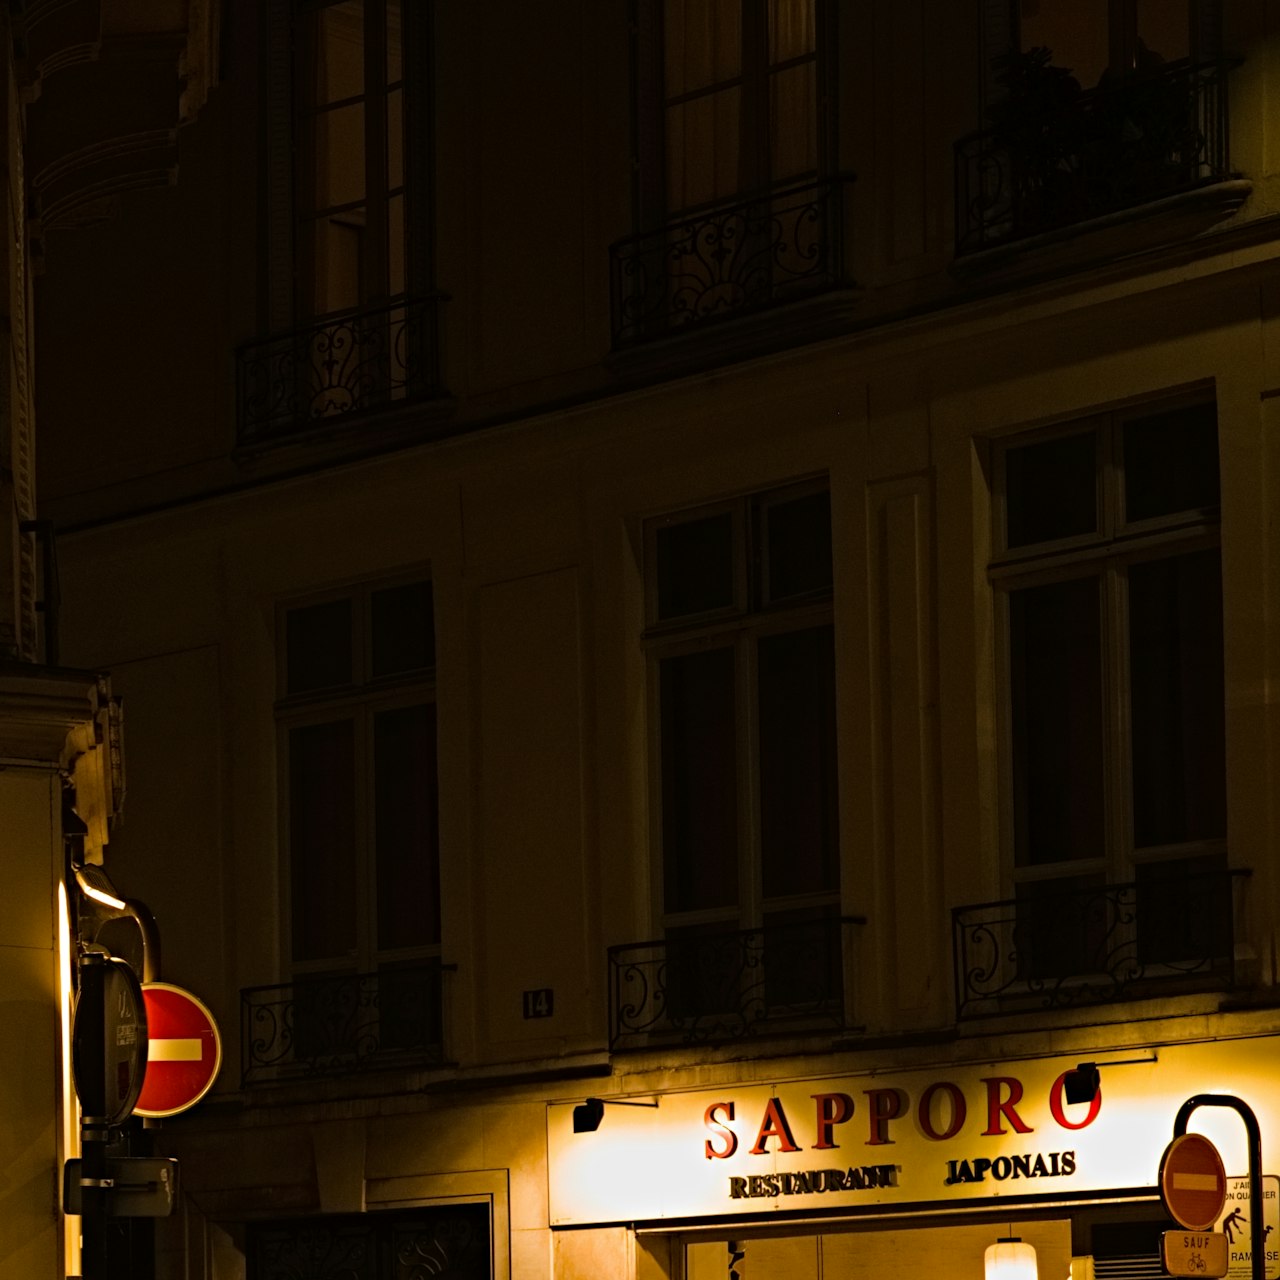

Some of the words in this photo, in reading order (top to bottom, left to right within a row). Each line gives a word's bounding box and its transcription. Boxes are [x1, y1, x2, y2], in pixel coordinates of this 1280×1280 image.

[528, 991, 549, 1017] 14
[704, 1067, 1103, 1161] SAPPORO
[728, 1164, 898, 1199] RESTAURANT
[945, 1151, 1077, 1186] JAPONAIS
[1183, 1236, 1210, 1249] SAUF
